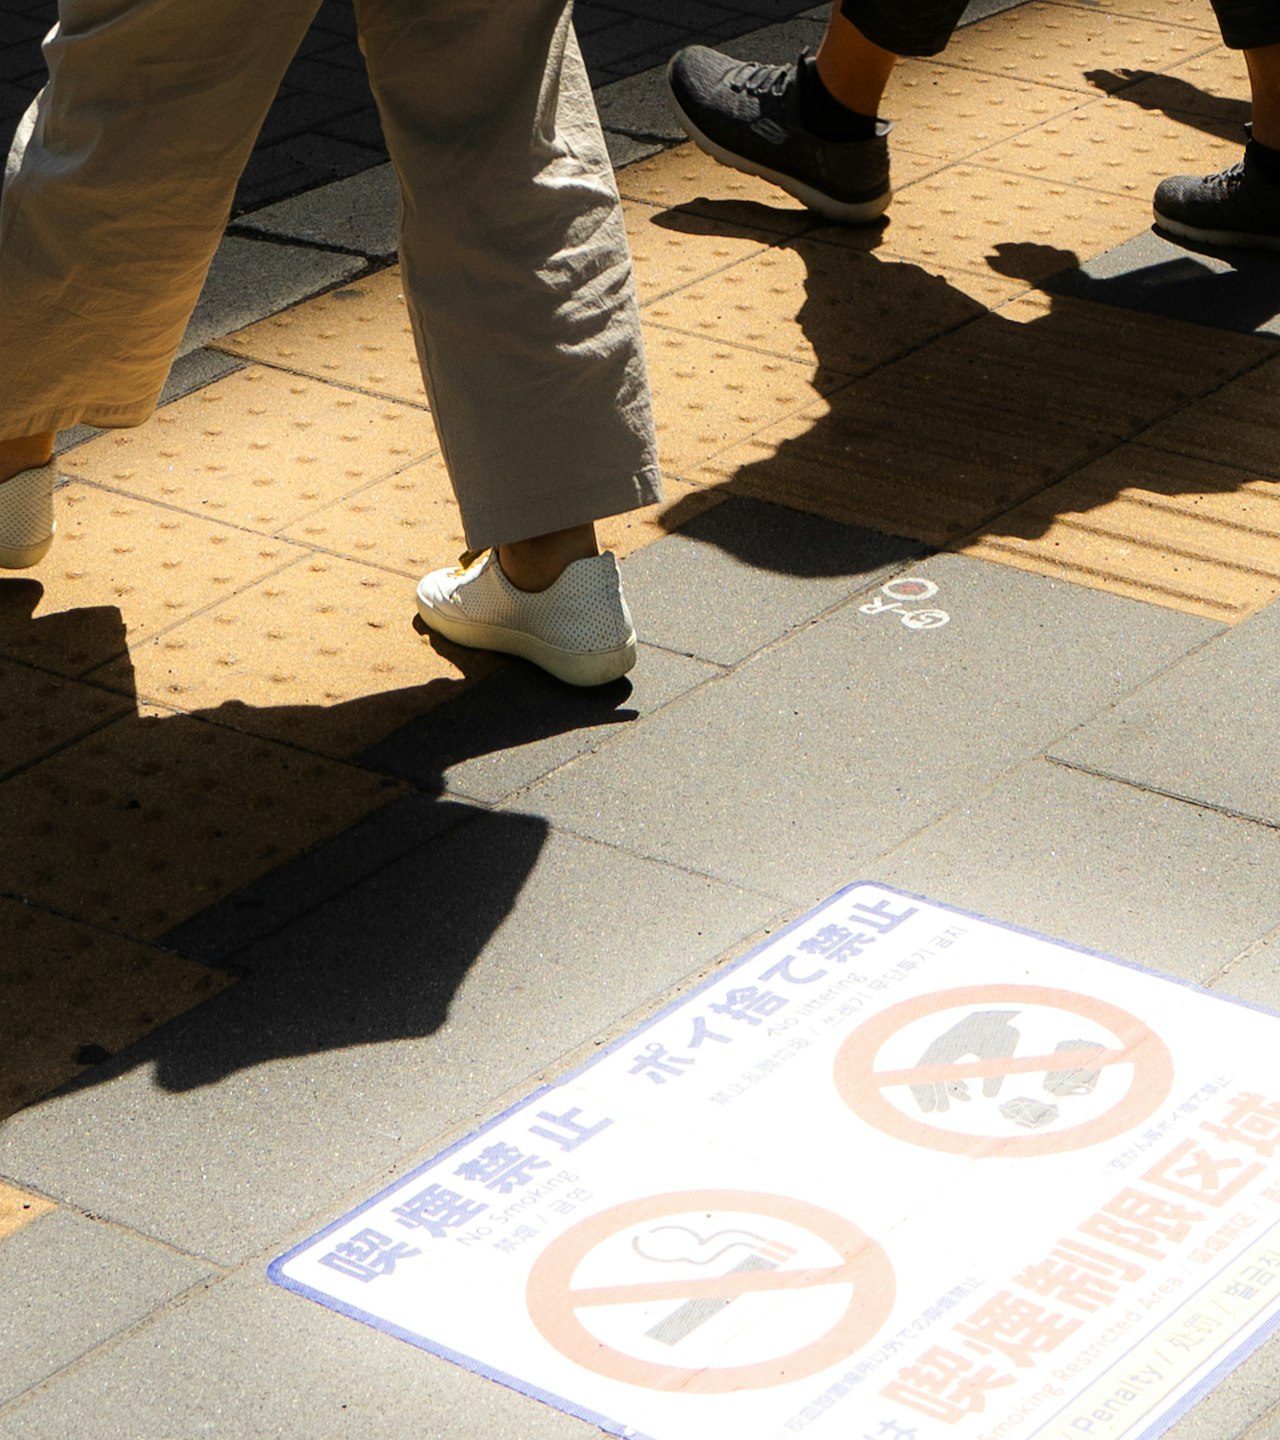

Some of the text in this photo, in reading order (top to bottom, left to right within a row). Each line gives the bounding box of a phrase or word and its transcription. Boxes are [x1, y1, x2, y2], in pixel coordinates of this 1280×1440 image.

[627, 899, 919, 1084] ポイ捨て禁止
[767, 971, 868, 1037] No littering
[317, 1106, 616, 1283] 喫煙禁止
[455, 1169, 580, 1247] No Smoking
[1051, 1307, 1143, 1382] Restricted
[1138, 1276, 1184, 1312] Area
[1070, 1365, 1163, 1435] Penalty
